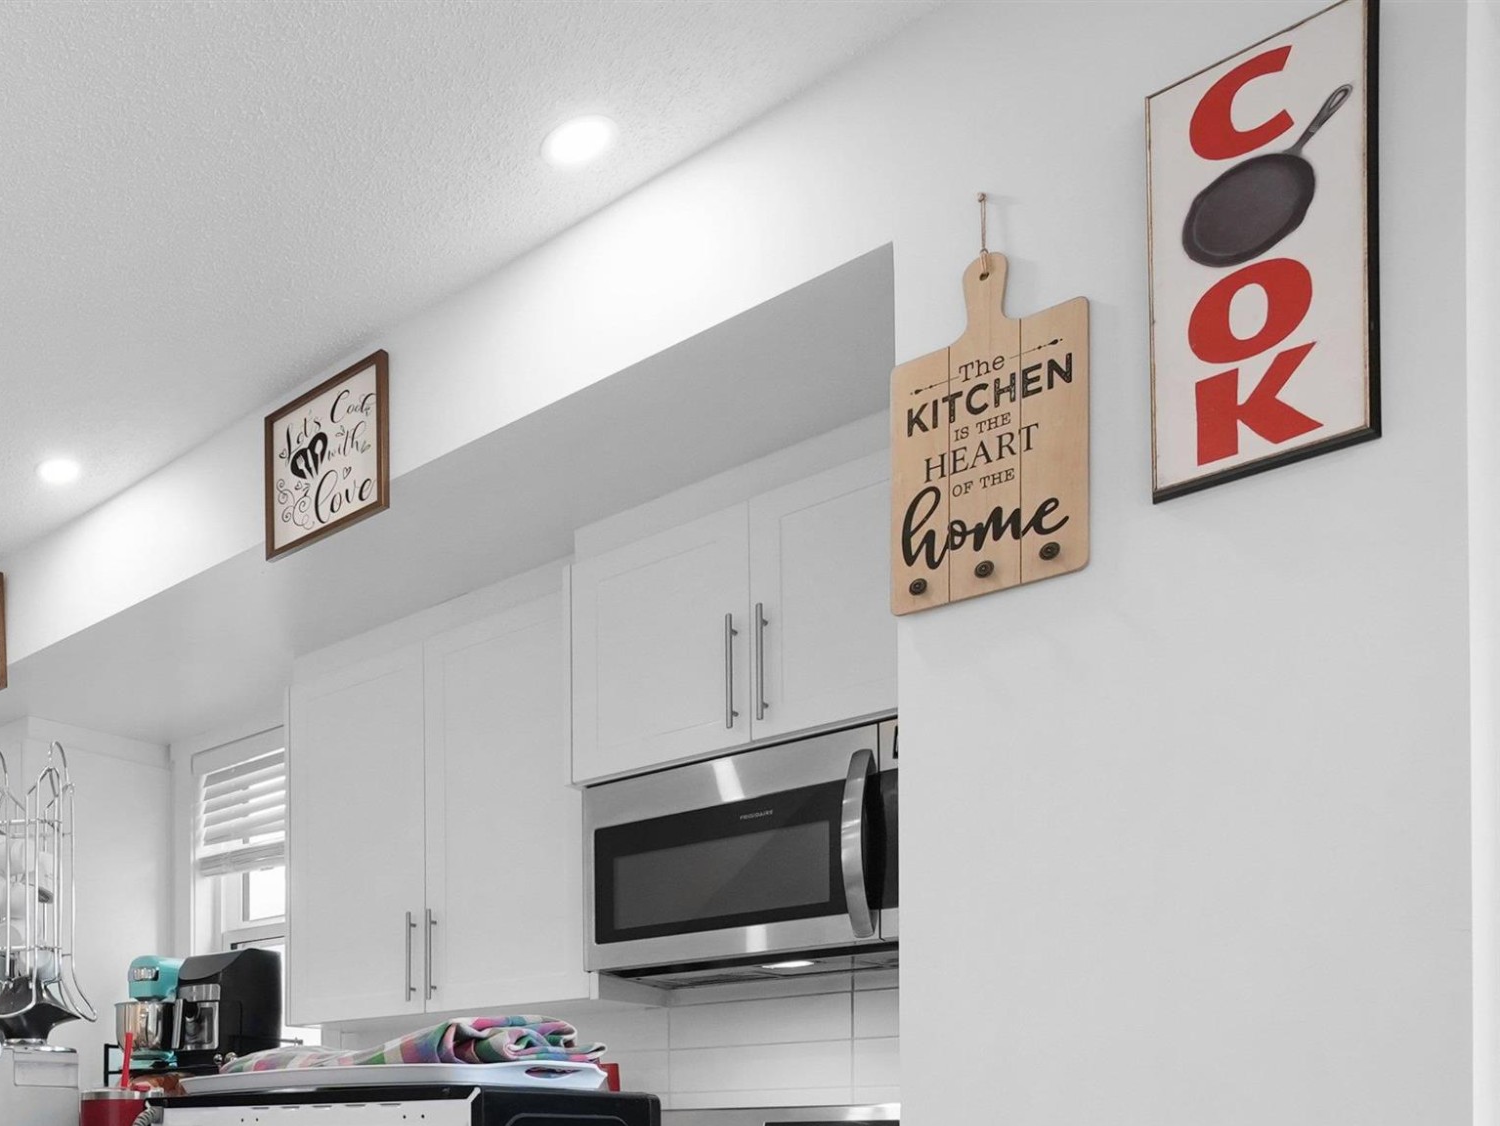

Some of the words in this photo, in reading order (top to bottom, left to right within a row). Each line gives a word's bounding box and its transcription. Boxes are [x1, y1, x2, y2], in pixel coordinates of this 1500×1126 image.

[958, 354, 1005, 384] The
[906, 352, 1074, 438] KITCHEN
[953, 424, 970, 442] IS
[976, 411, 1012, 436] THE
[923, 422, 1040, 483] HEART
[952, 481, 974, 498] OF
[979, 467, 1016, 492] THE
[901, 485, 1070, 571] home
